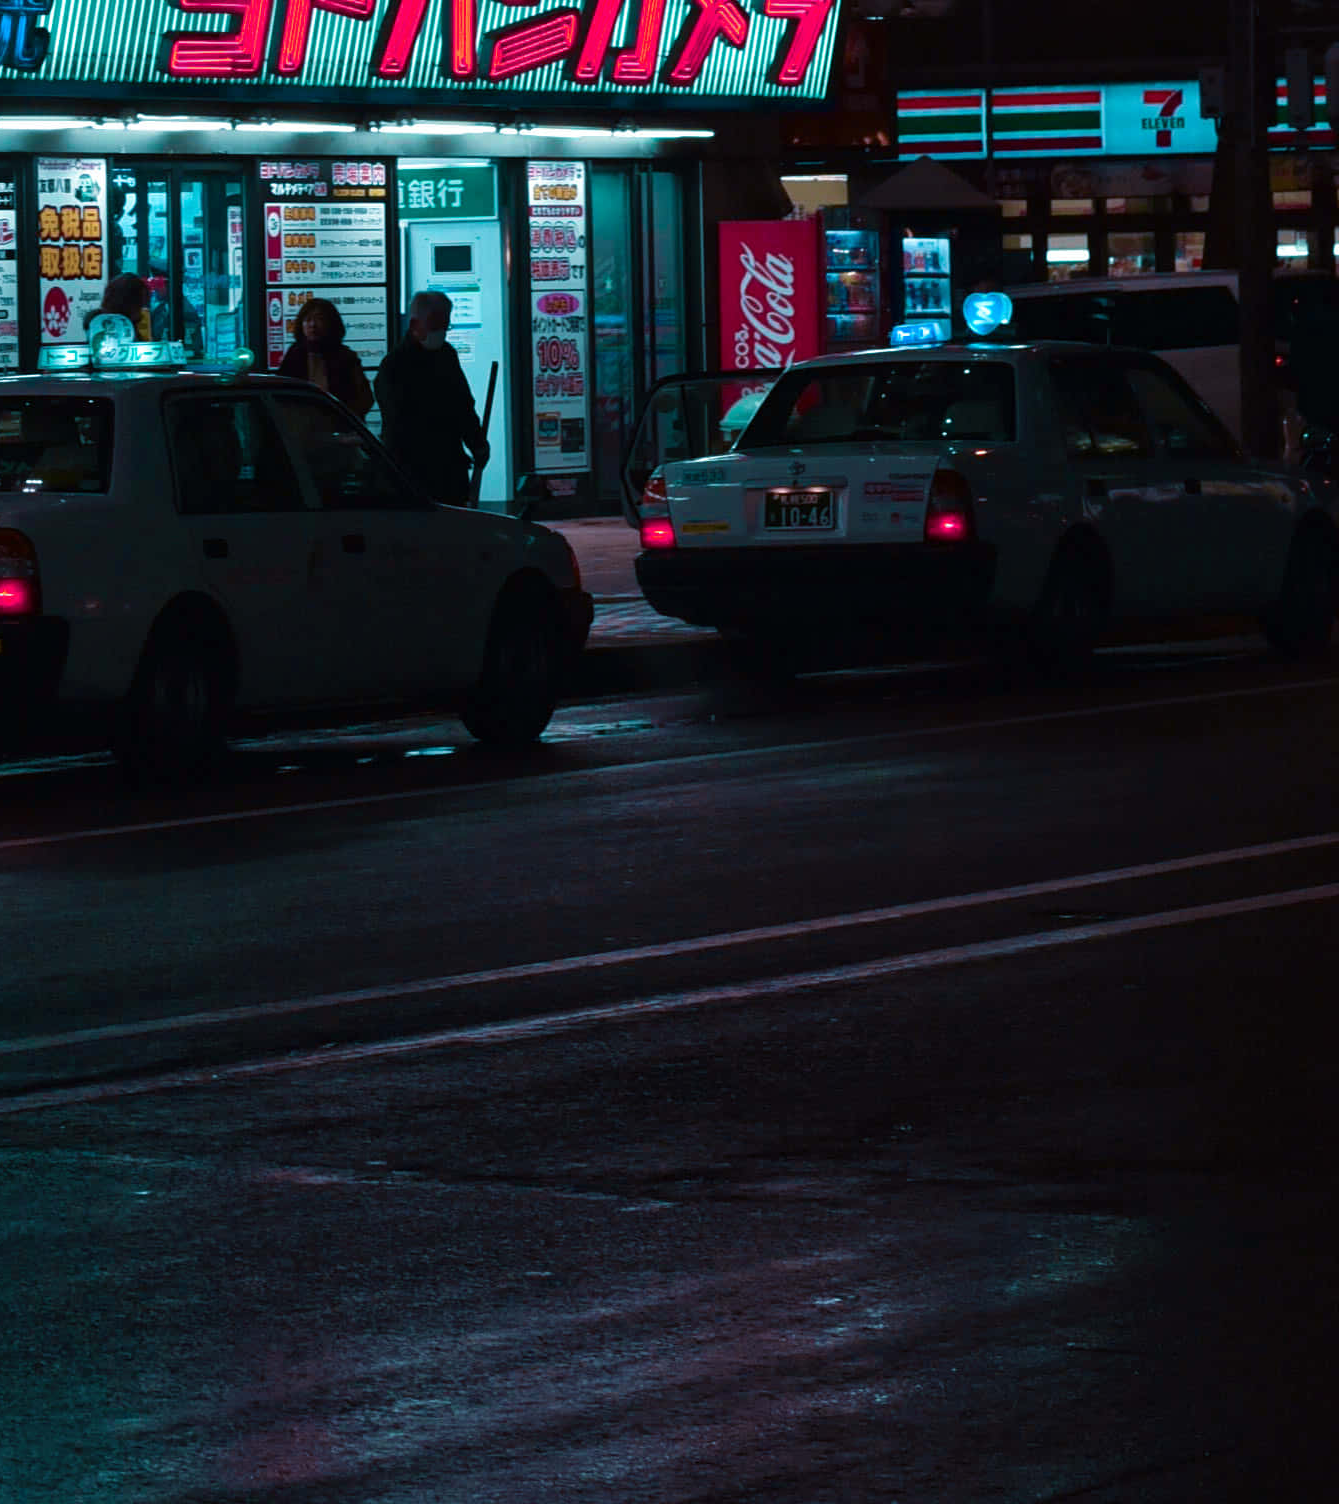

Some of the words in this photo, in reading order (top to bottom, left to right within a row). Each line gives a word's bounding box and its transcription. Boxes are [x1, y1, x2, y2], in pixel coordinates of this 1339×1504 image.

[1143, 88, 1183, 148] 7
[331, 161, 387, 186] 売場案内
[38, 204, 102, 242] 免税品
[39, 242, 103, 280] 取扱店
[536, 335, 581, 373] 10%
[780, 506, 830, 527] 10-46
